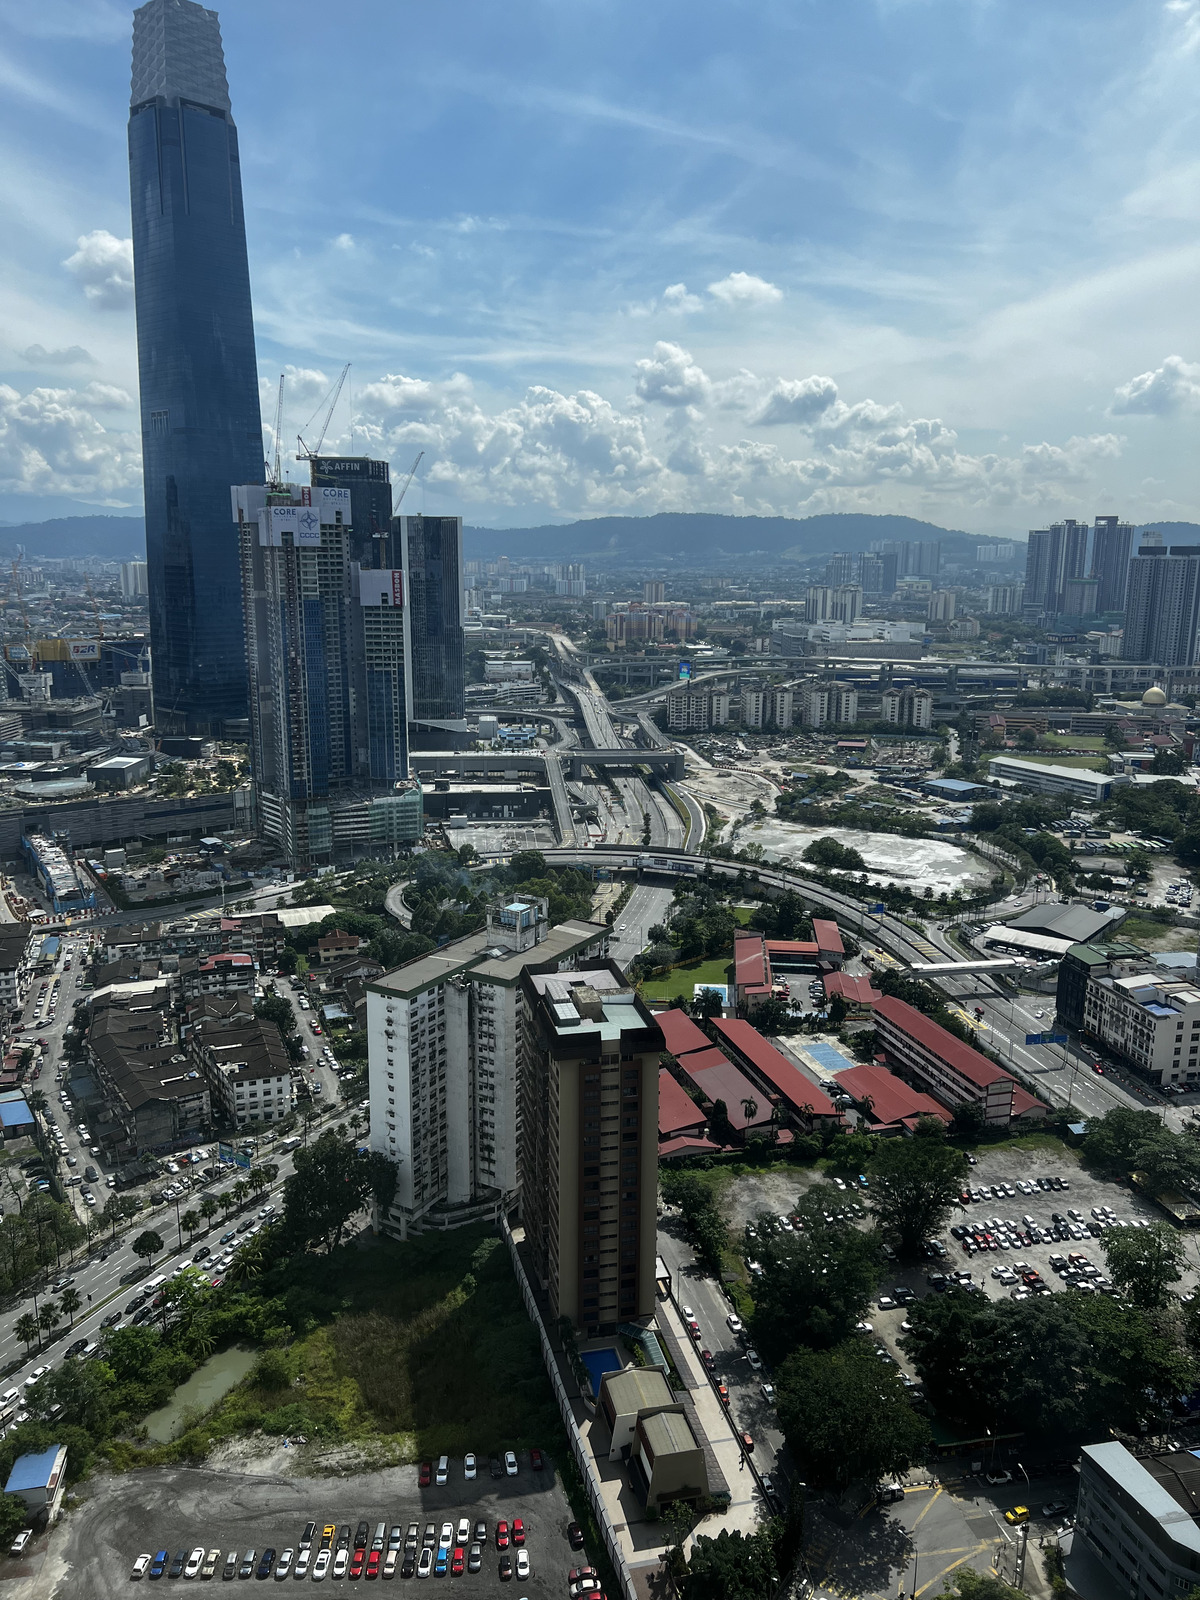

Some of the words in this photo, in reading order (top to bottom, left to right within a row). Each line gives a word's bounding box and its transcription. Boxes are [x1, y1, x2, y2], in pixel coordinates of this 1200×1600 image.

[334, 463, 360, 471] AFFIN
[323, 489, 349, 498] CORE
[274, 508, 296, 516] CORE
